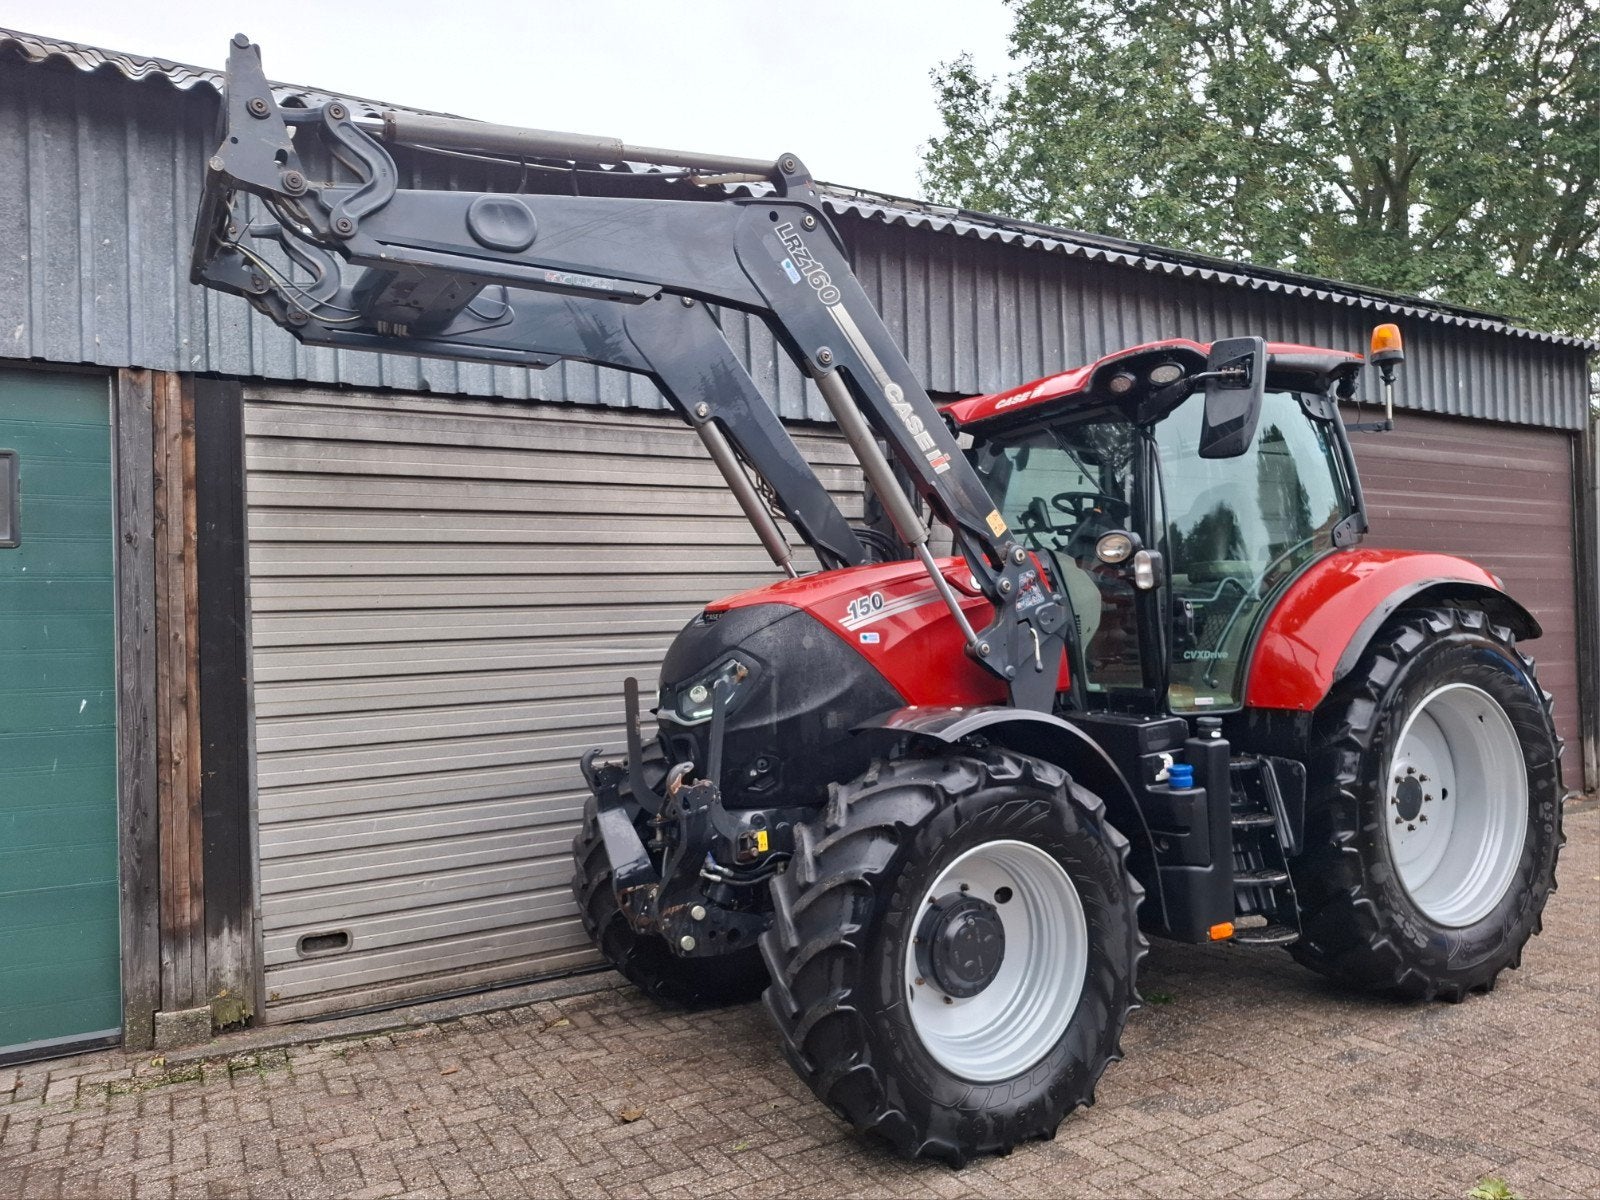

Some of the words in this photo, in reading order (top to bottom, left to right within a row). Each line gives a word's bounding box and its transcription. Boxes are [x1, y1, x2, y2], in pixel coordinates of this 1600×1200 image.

[995, 389, 1031, 410] CASE
[884, 382, 936, 452] CASE
[847, 591, 885, 620] 150
[1183, 650, 1229, 660] CVXDrive
